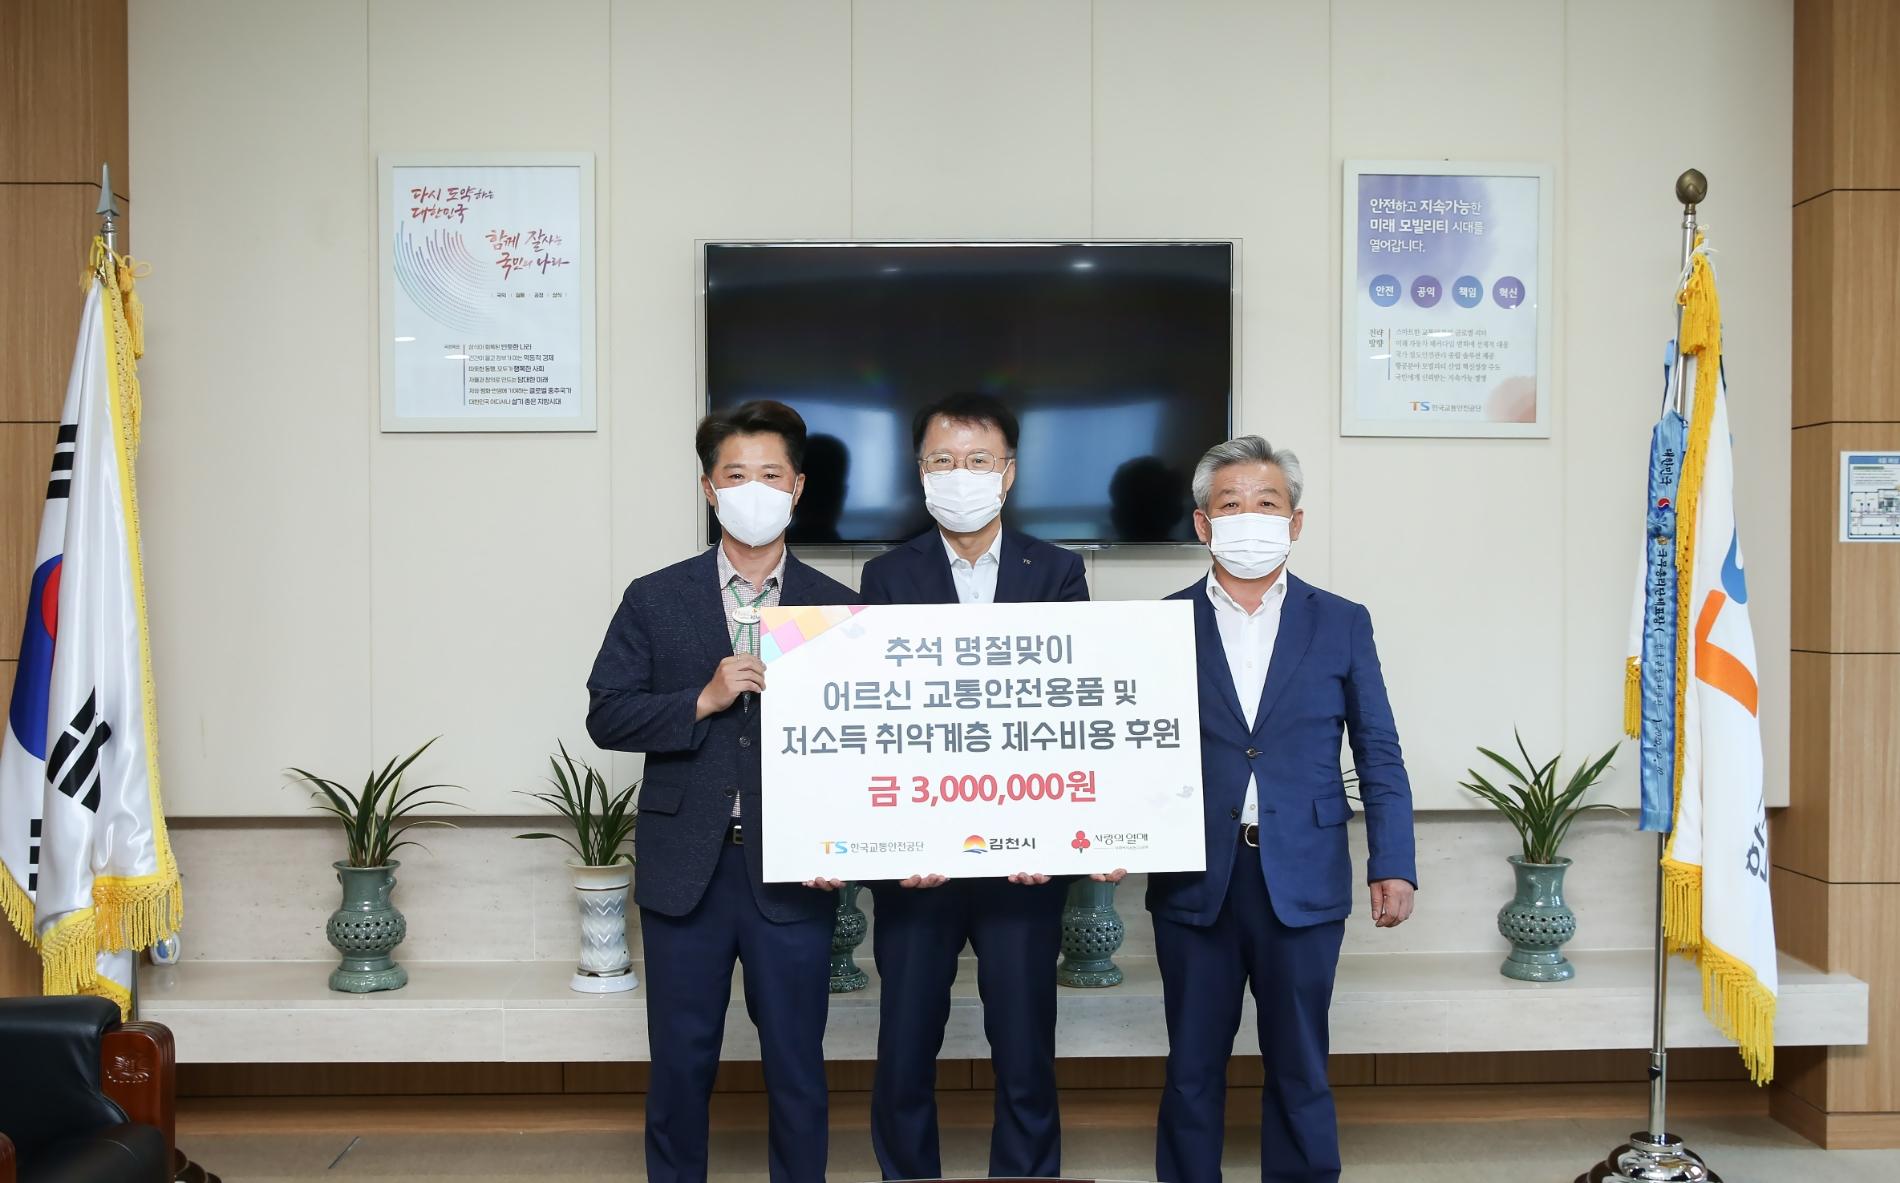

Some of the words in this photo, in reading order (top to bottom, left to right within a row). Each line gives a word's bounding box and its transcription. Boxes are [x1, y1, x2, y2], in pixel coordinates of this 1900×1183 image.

[411, 186, 441, 203] 다시
[446, 186, 494, 201] 도약하는
[1370, 198, 1417, 214] 안전하고
[1420, 199, 1482, 215] 지속가능한
[411, 204, 468, 223] 대한민국
[1370, 218, 1395, 233] 미래
[1399, 219, 1448, 234] 모빌리티
[1452, 221, 1484, 235] 시대를
[484, 229, 520, 250] 함께
[525, 229, 562, 251] 잘사는
[1370, 239, 1425, 253] 열어갑니다.
[496, 252, 532, 280] 국민의
[537, 253, 569, 274] 나라
[1376, 285, 1394, 297] 안전
[1417, 286, 1435, 298] 공익
[1459, 287, 1476, 298] 책임
[1499, 287, 1517, 299] 혁신
[1369, 328, 1384, 337] 전략
[1455, 329, 1473, 337] 글로벌
[1368, 339, 1384, 347] 방향
[1410, 340, 1428, 348] 자동차
[1456, 340, 1475, 348] 변화에
[1448, 374, 1472, 382] 지속가능
[1410, 402, 1430, 411] TS
[1432, 404, 1481, 412] 한국교통안전공단
[1660, 448, 1675, 486] 대한민국
[884, 636, 942, 667] 추석
[955, 635, 1073, 667] 명절맞이
[823, 679, 911, 711] 어르신
[923, 677, 1105, 710] 교통안전용품
[1113, 679, 1137, 706] 및
[781, 722, 868, 756] 저소득
[875, 721, 992, 754] 취약계층
[1001, 720, 1116, 752] 제수비용
[1125, 718, 1181, 749] 후원
[868, 776, 901, 807] 금
[912, 770, 1097, 806] 3,000,000원
[989, 837, 1036, 851] 김천시
[1093, 834, 1123, 845] 사랑의
[1126, 833, 1148, 844] 열매
[820, 841, 848, 854] TS
[850, 840, 924, 853] 한국교통안전공단
